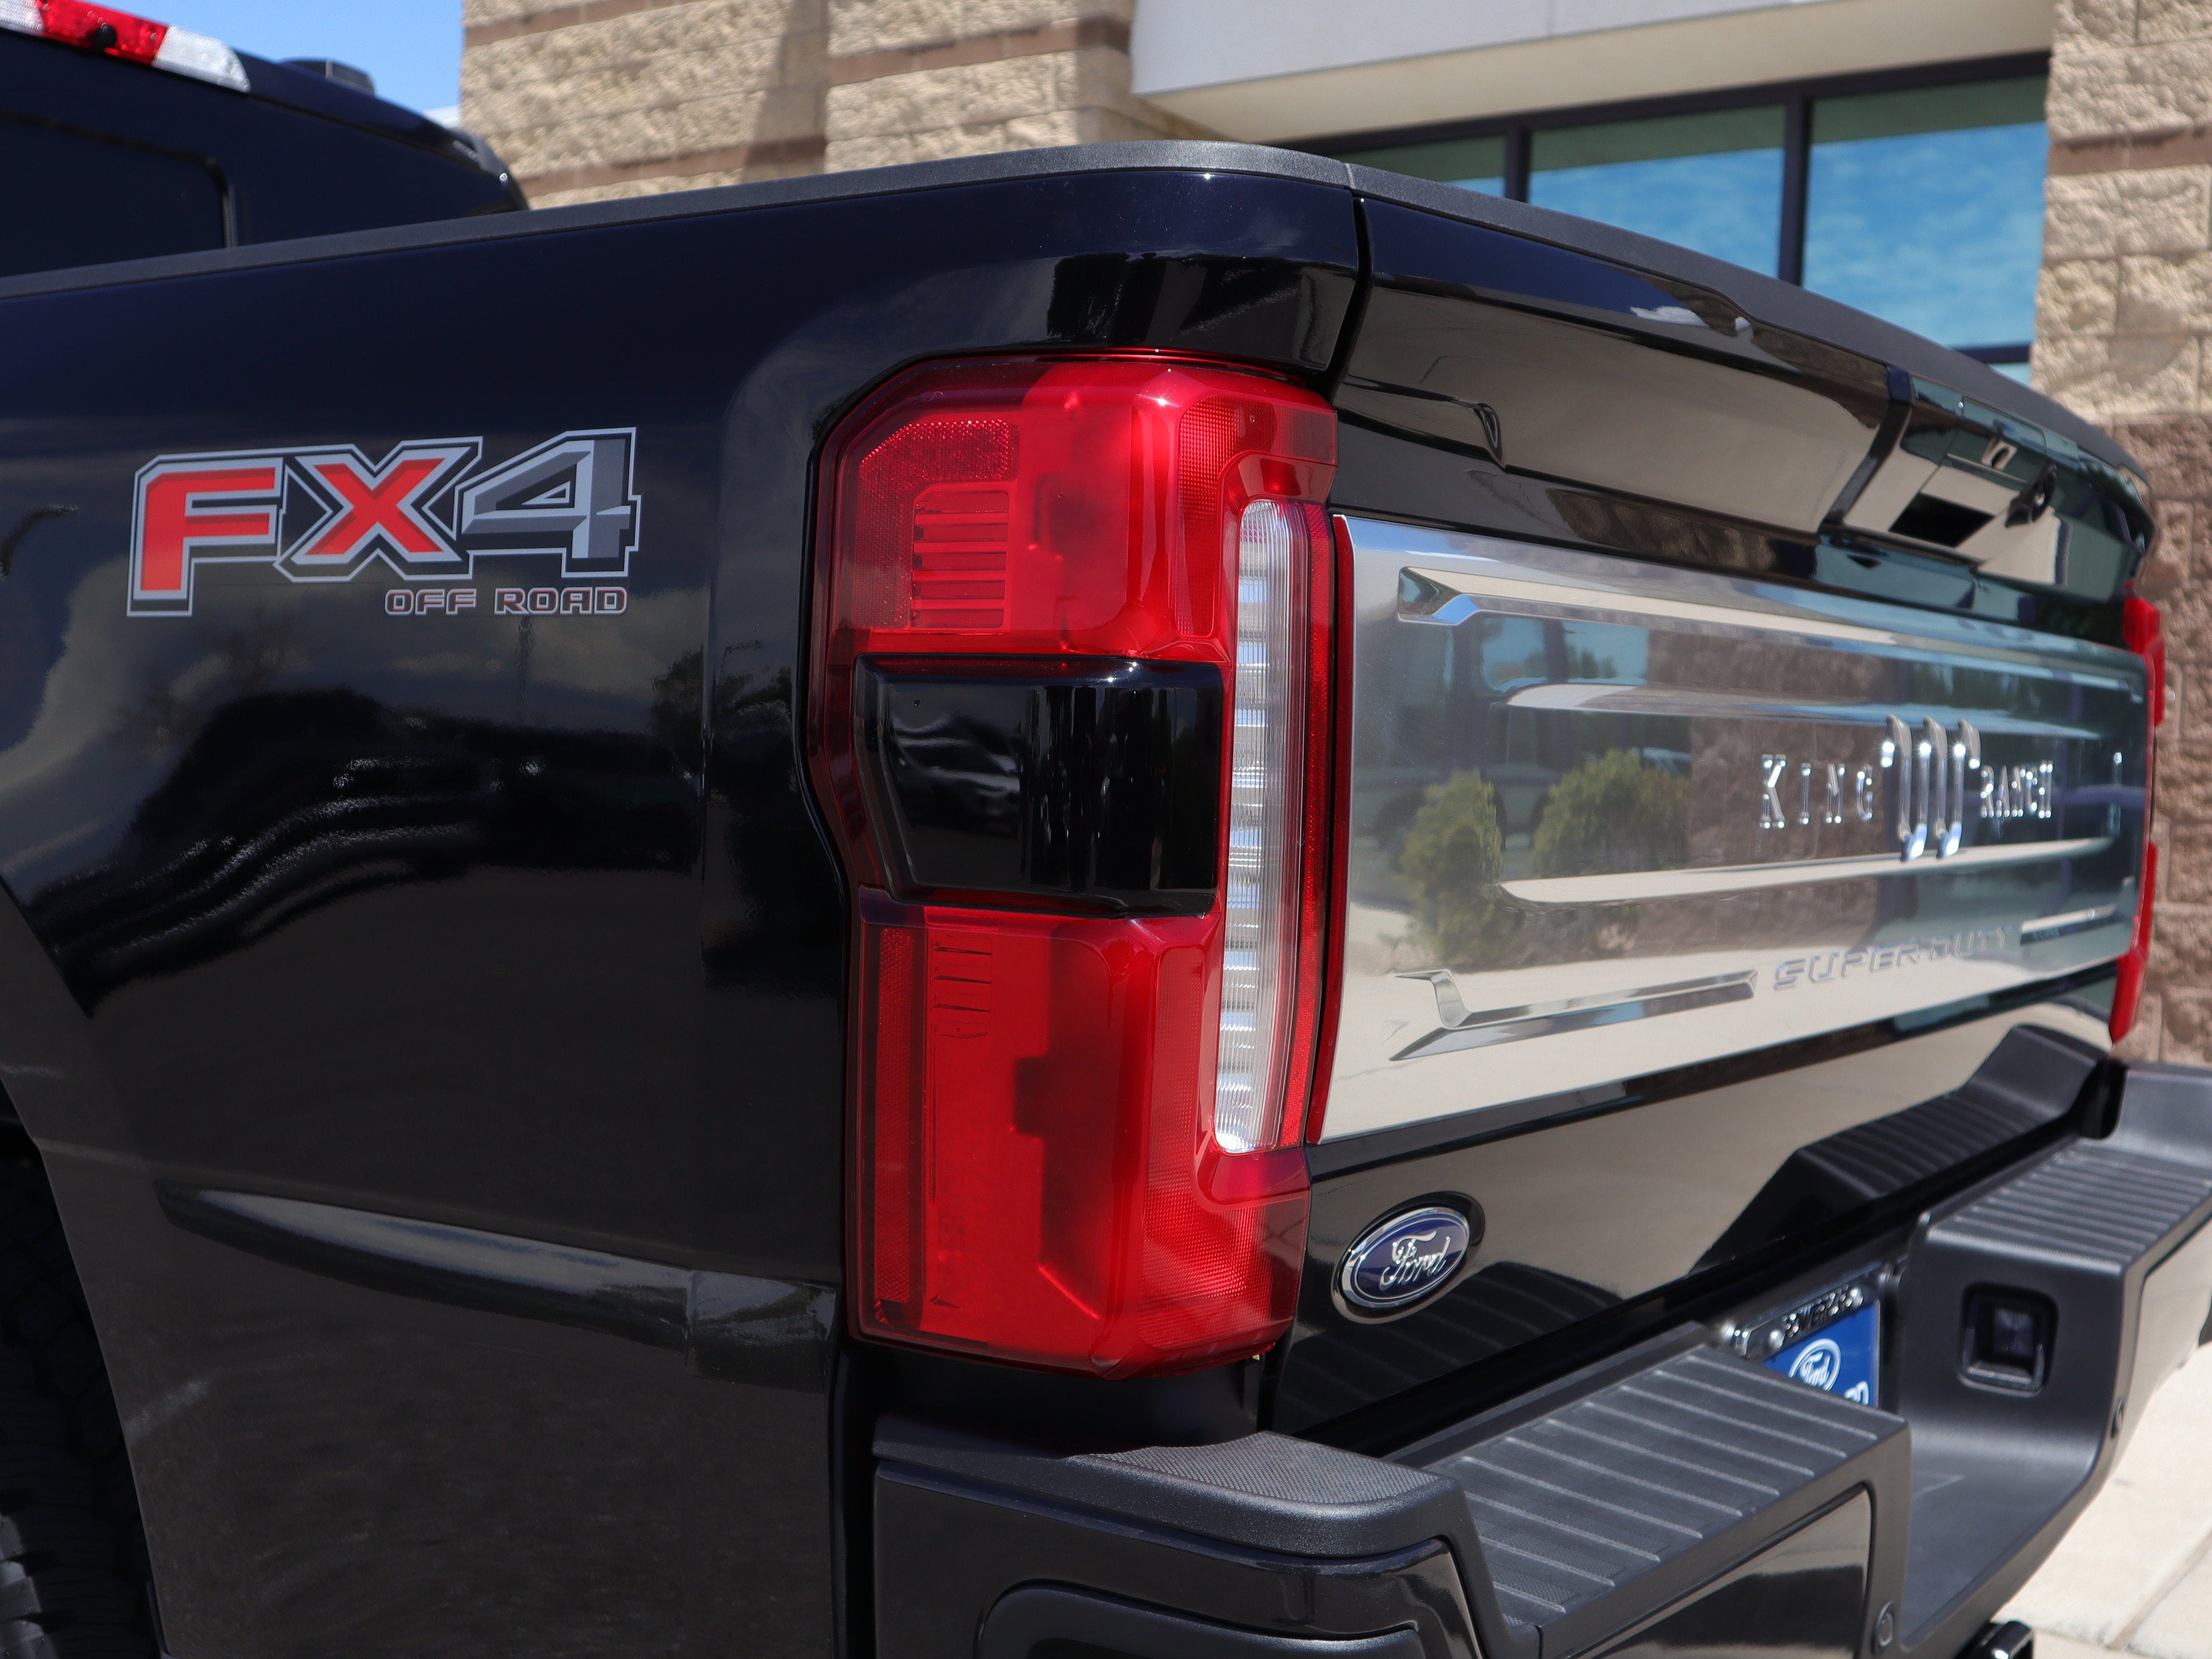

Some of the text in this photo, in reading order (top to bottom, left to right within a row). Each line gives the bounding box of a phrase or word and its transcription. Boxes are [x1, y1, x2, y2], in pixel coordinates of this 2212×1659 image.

[127, 427, 641, 617] FX4
[384, 586, 628, 615] OFF ROAD
[1760, 754, 1873, 829] KING
[1773, 924, 2013, 991] SUPER DUTY
[1379, 1230, 1452, 1291] Ford
